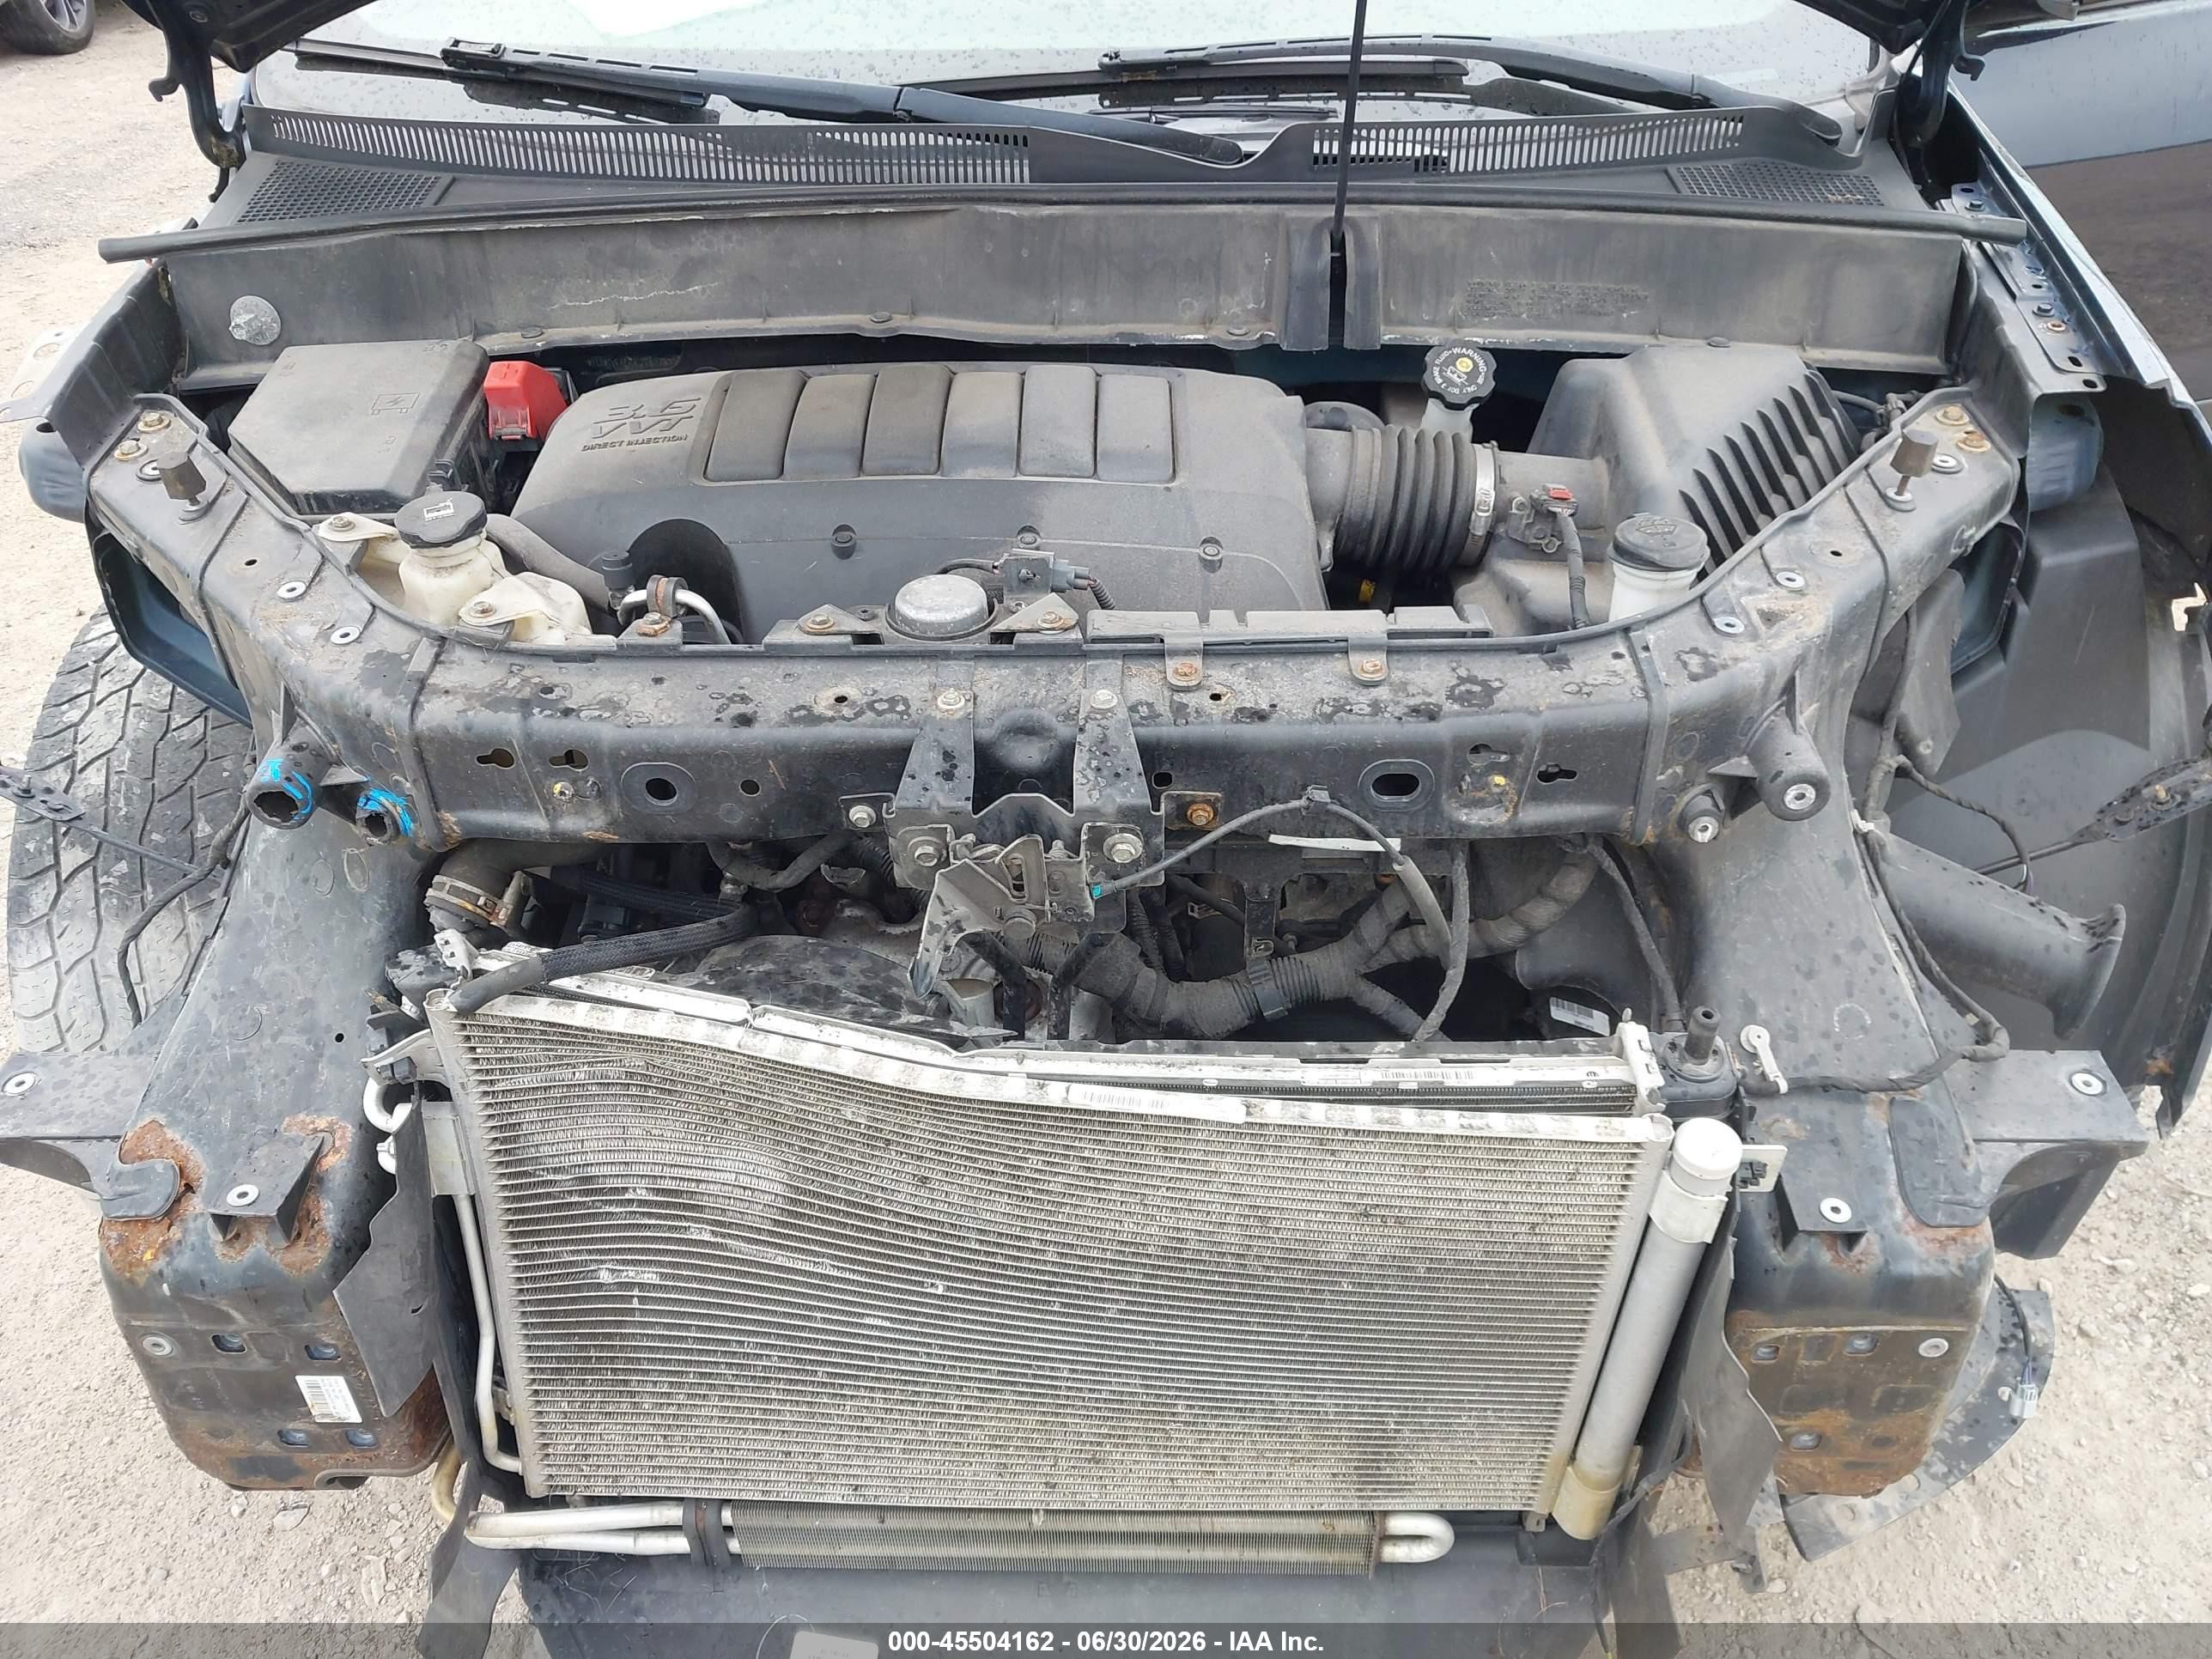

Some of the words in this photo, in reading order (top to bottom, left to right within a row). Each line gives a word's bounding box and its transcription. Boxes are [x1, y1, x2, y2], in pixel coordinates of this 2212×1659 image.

[1435, 350, 1450, 365] FLUID
[1452, 347, 1486, 372] WARNING
[592, 398, 702, 424] 3.6
[591, 416, 694, 439] VVT
[581, 440, 624, 452] DIRECT
[626, 434, 688, 447] INJECTION
